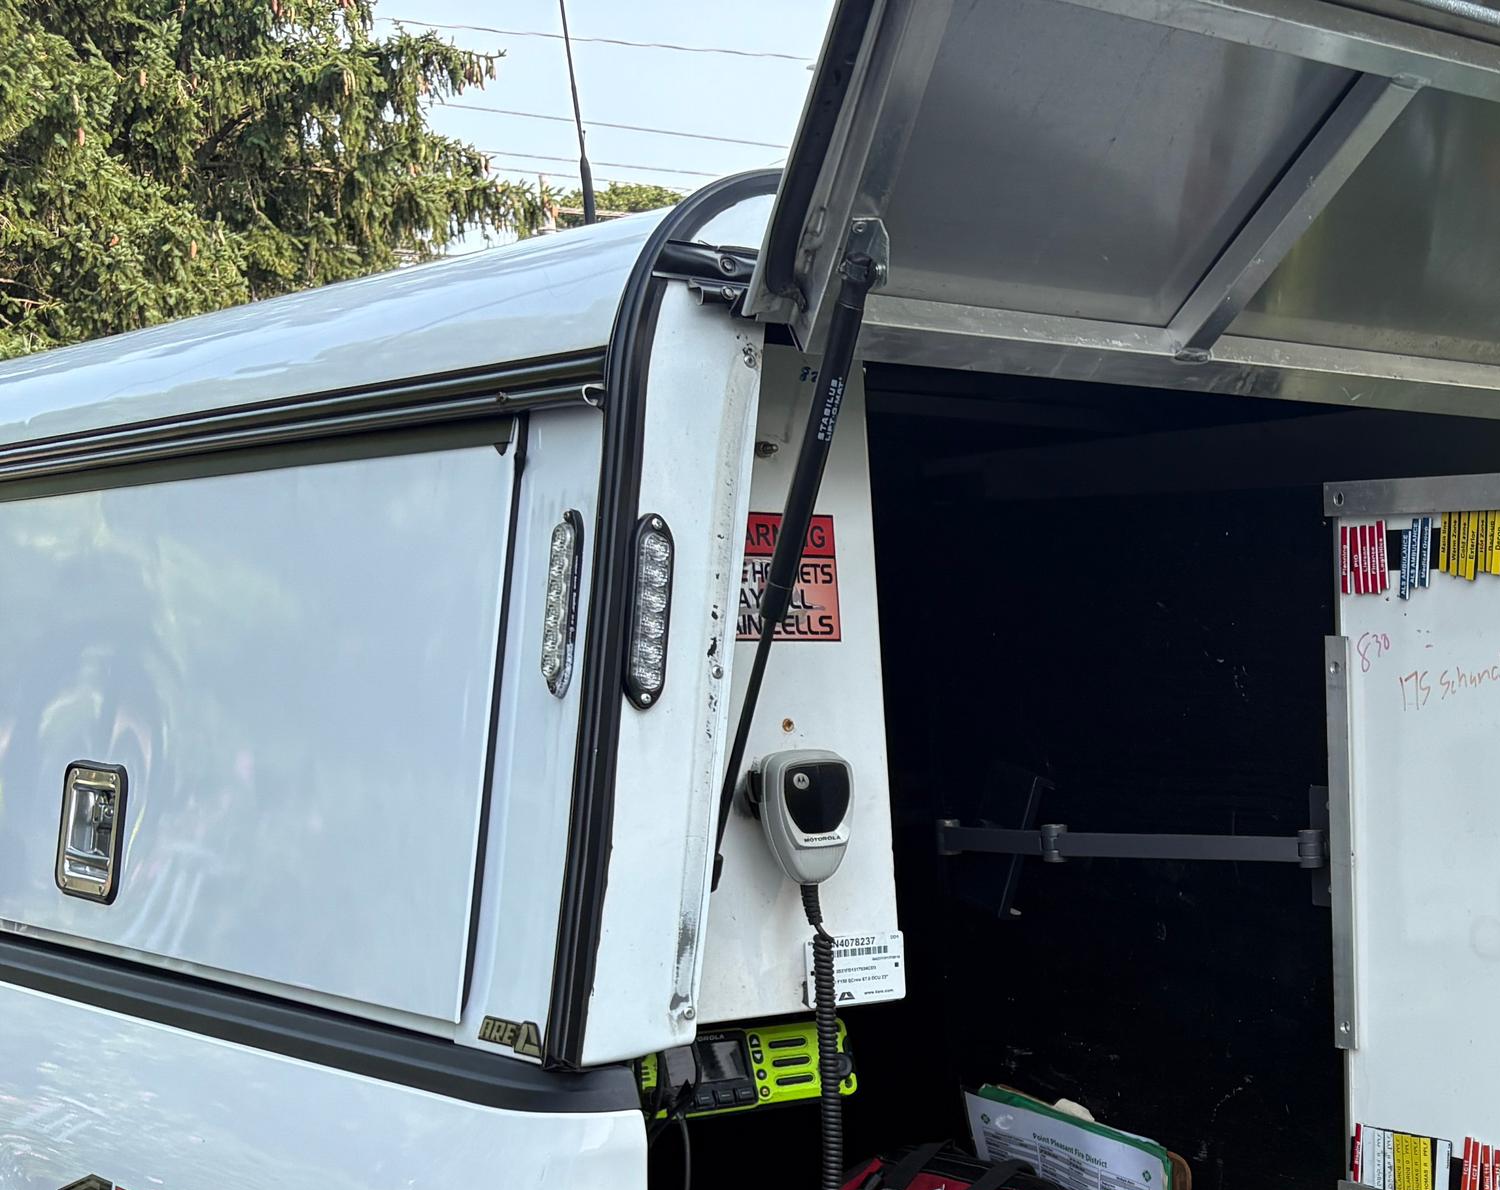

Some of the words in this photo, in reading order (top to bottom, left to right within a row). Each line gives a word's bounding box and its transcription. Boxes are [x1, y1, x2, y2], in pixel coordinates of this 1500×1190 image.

[818, 380, 838, 440] STABILUS
[804, 835, 841, 843] MOTOROLA
[1032, 1132, 1050, 1144] Point
[1050, 1138, 1074, 1154] Pleasant
[1074, 1148, 1085, 1159] Fire
[1086, 1154, 1108, 1168] District
